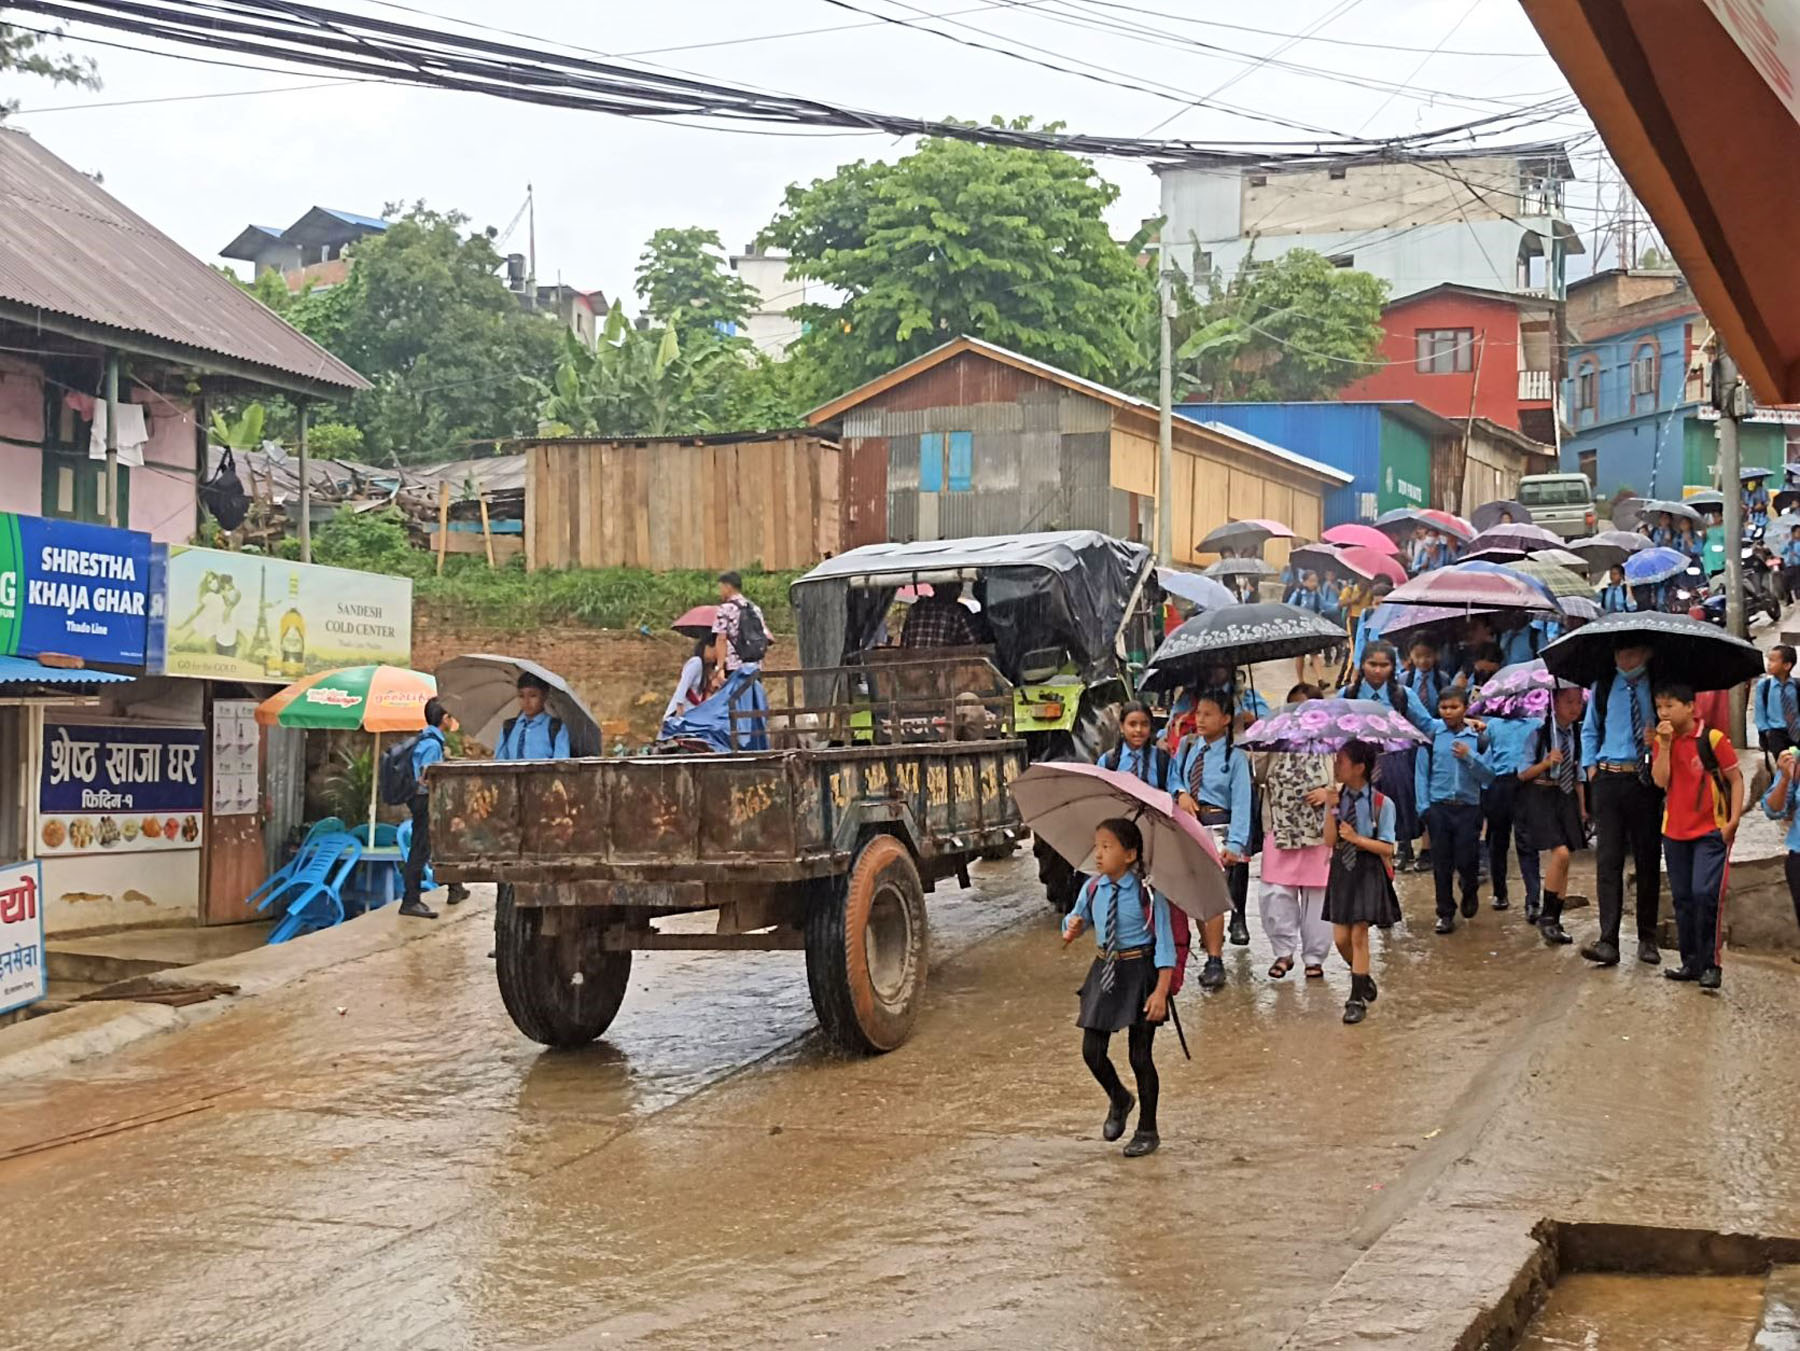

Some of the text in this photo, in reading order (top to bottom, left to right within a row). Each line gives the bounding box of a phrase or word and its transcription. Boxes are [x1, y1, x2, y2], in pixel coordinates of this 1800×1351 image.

[41, 546, 136, 581] SHRESTHA
[28, 579, 90, 615] KHAJA
[93, 588, 145, 615] GHAR
[337, 602, 382, 619] SANDESH
[91, 623, 108, 635] Line
[325, 620, 395, 638] COLD CENTER
[50, 727, 199, 785] श्रेष्ठ खाजा घर
